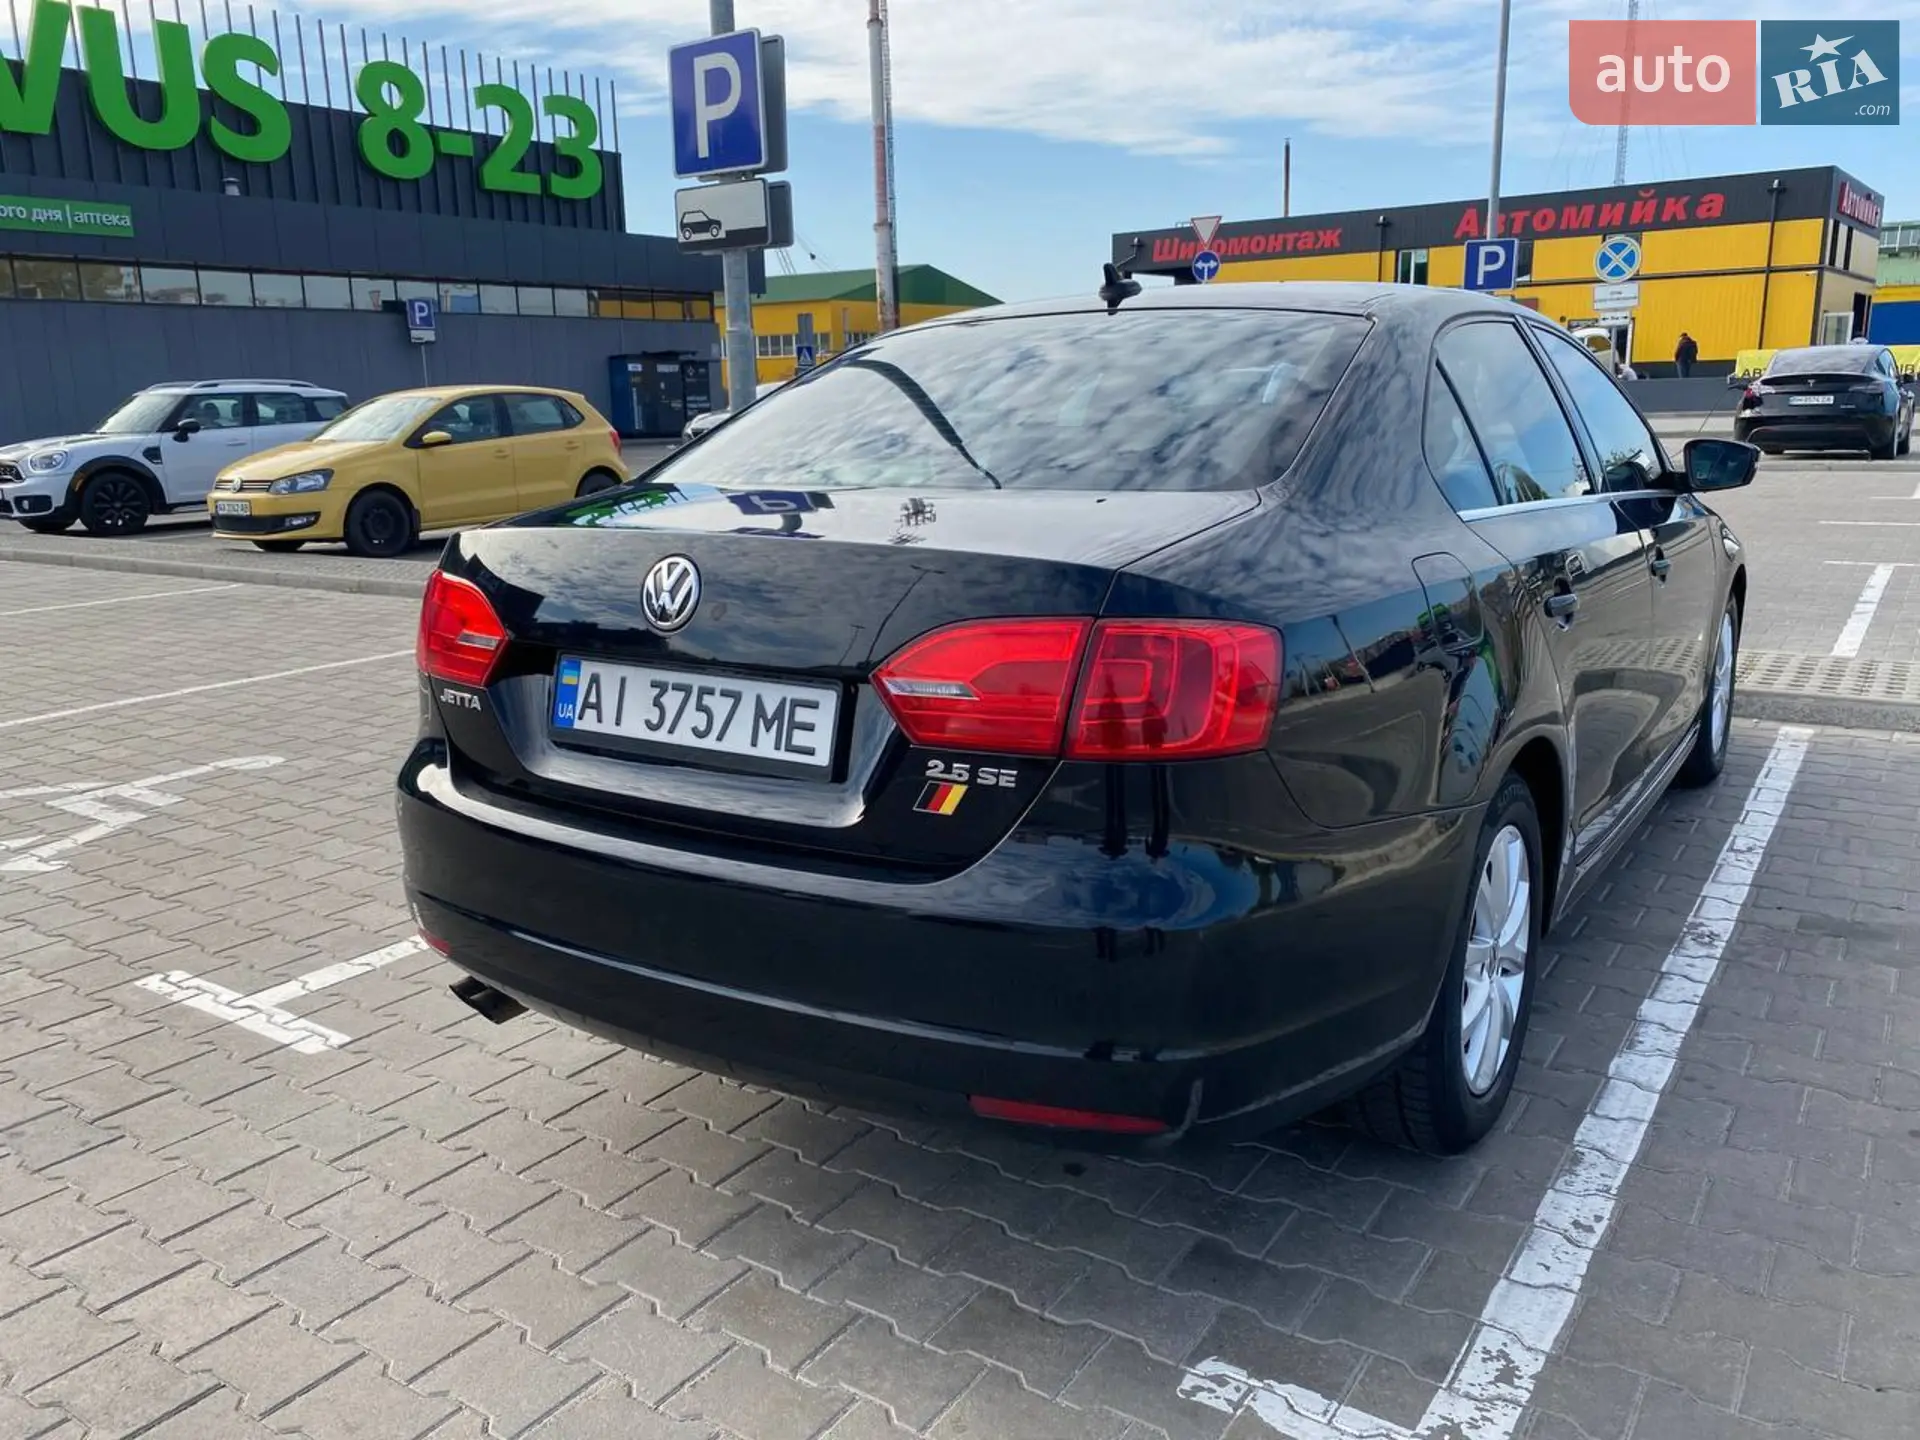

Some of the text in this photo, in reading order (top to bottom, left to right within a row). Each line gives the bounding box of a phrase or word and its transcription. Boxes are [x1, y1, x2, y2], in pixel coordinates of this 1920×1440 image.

[693, 51, 742, 159] P
[355, 60, 603, 199] 8-23
[31, 208, 62, 223] дня
[74, 211, 131, 226] аптека
[1476, 245, 1506, 286] P
[414, 301, 428, 325] P
[440, 687, 482, 712] JETTA
[557, 703, 574, 720] UA
[577, 672, 820, 757] AI 3757 ME
[976, 767, 1018, 788] SE
